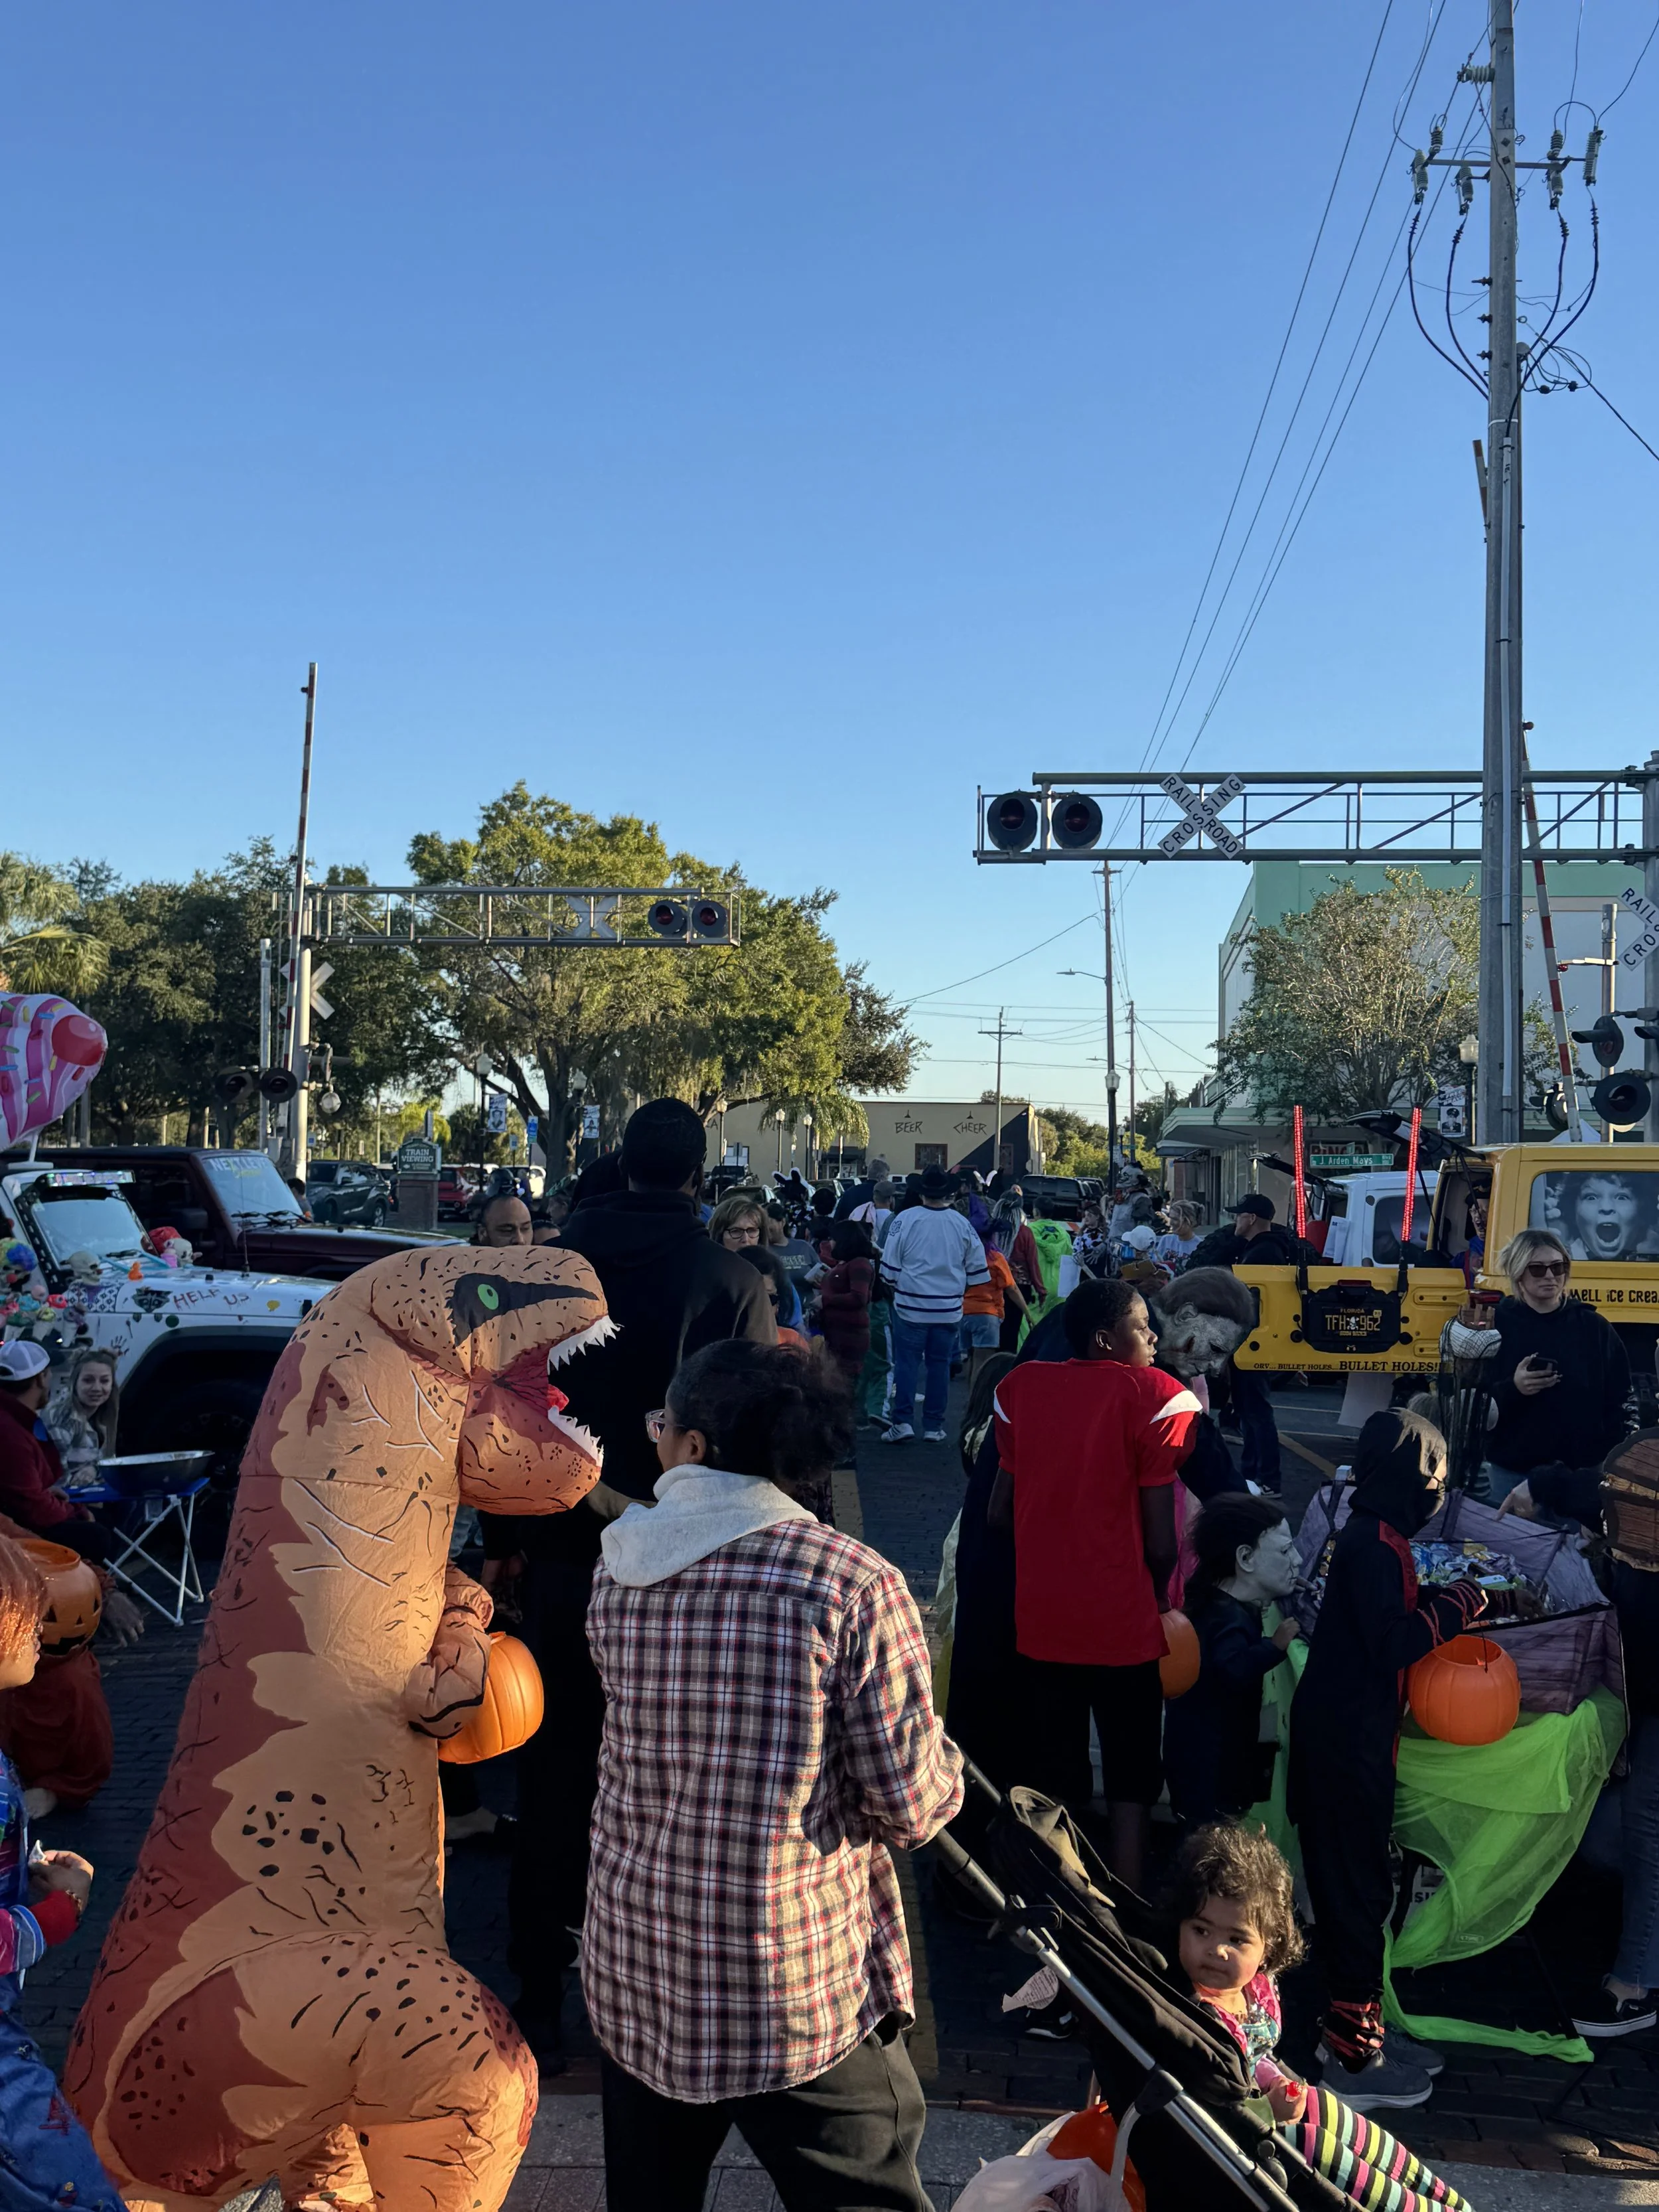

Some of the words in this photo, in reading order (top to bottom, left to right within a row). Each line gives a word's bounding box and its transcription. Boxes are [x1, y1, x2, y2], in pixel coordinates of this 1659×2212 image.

[1163, 776, 1196, 813] RAIL
[1204, 818, 1238, 853] ROAD
[1163, 779, 1241, 853] CROSSING
[1621, 887, 1656, 924] RAIL
[895, 1121, 923, 1134] BEER
[953, 1122, 987, 1136] CHEER
[209, 1157, 244, 1173] NEXT
[1328, 1156, 1350, 1165] Arden
[1352, 1156, 1373, 1165] Mays
[173, 1289, 220, 1311] HELP
[224, 1293, 250, 1309] US
[1339, 1361, 1388, 1371] BULLET
